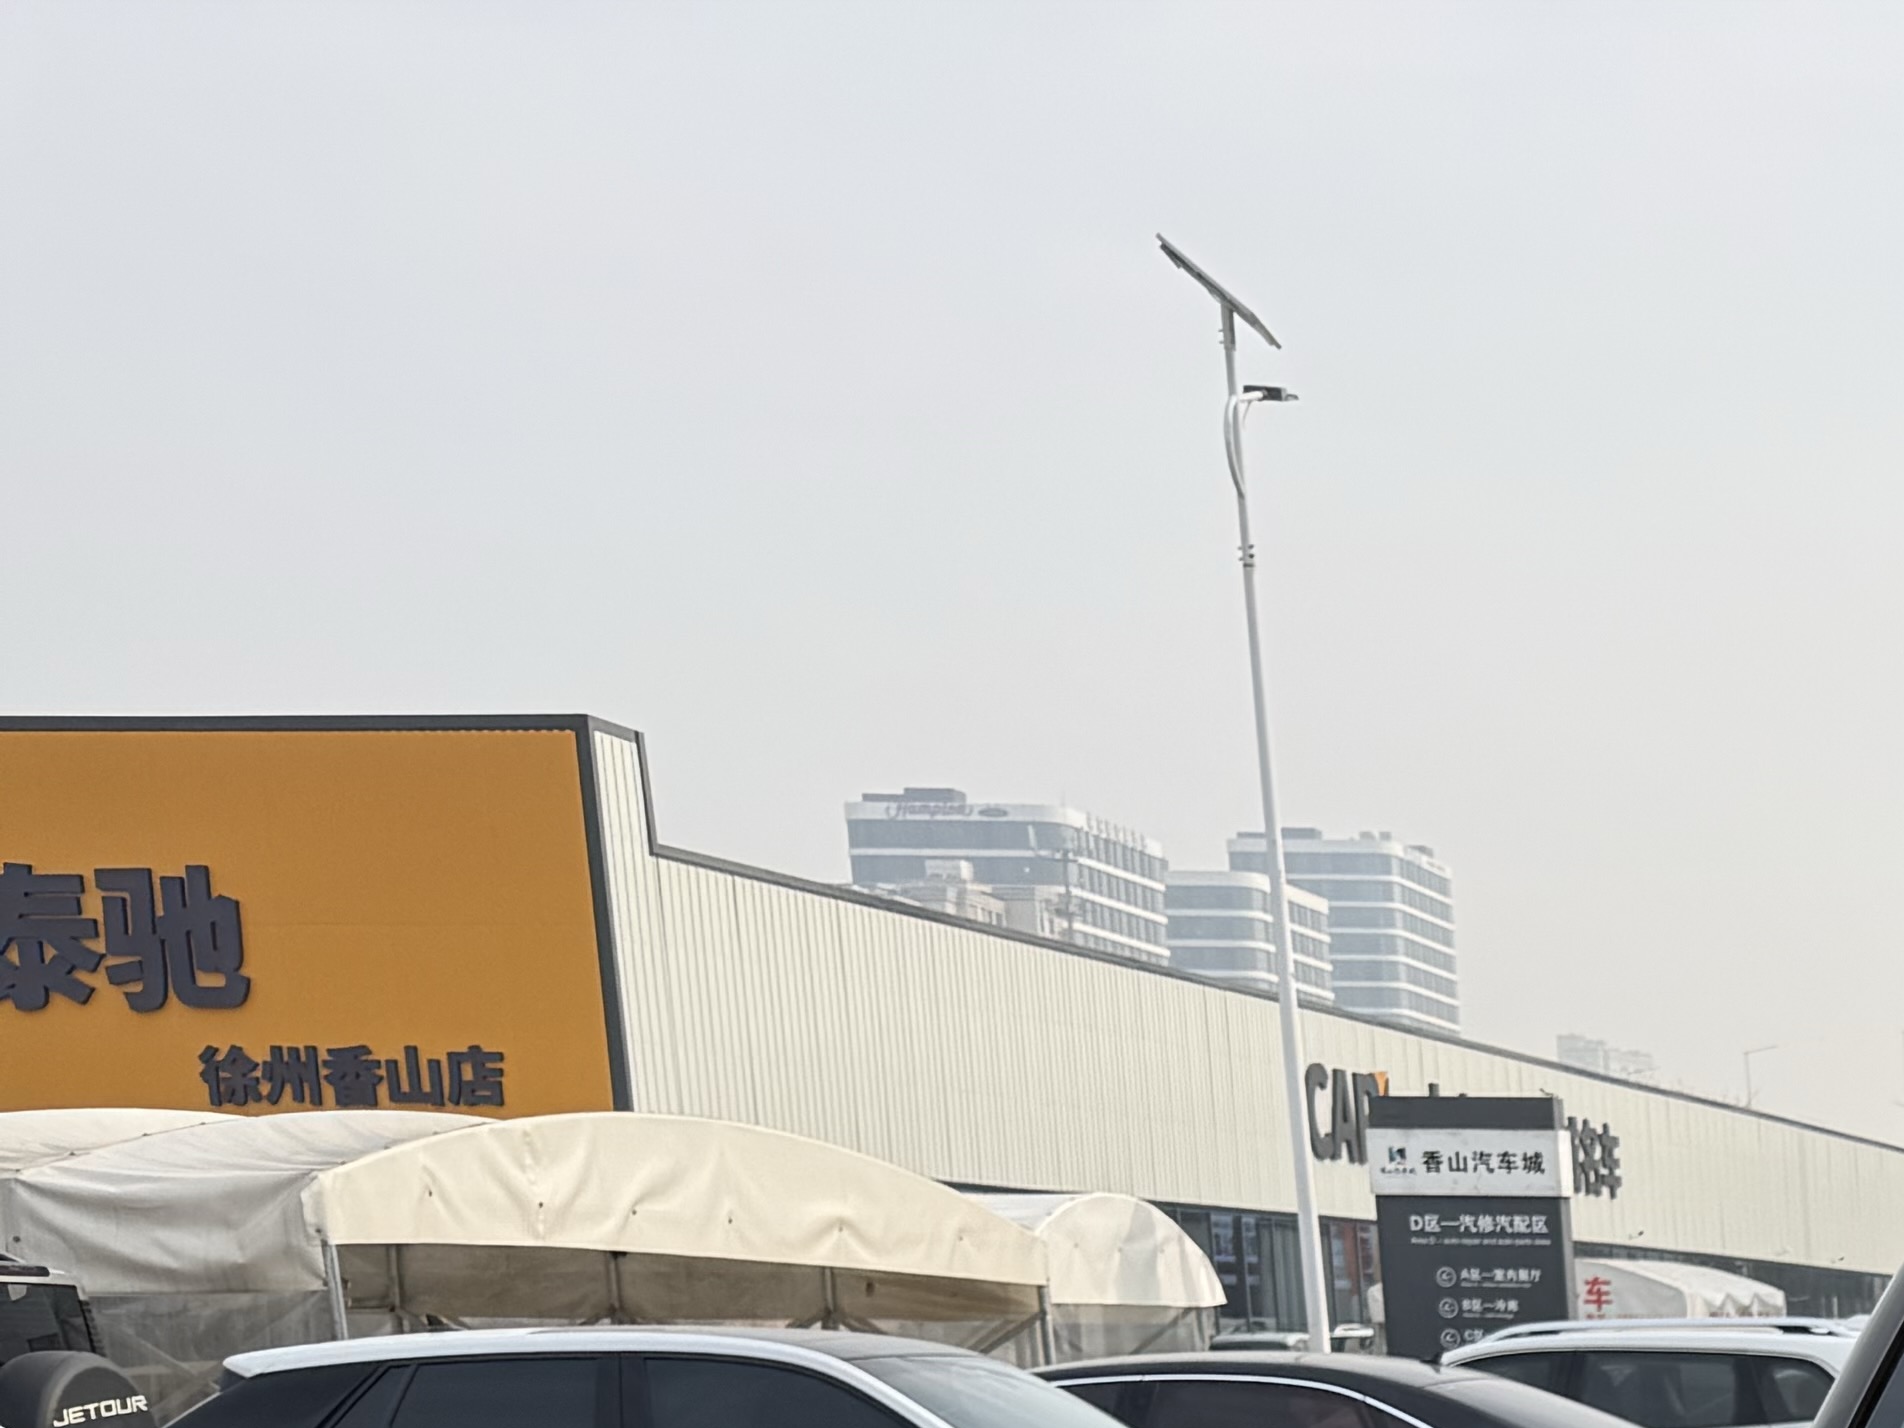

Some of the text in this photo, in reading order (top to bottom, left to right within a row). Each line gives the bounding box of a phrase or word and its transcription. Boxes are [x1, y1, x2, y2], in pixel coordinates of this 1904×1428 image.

[0, 862, 252, 1013] 泰驰
[200, 1045, 505, 1107] 徐州香山店
[1423, 1150, 1546, 1174] 香山汽车城
[1583, 1276, 1612, 1312] 车
[53, 1395, 148, 1427] JETOUR
